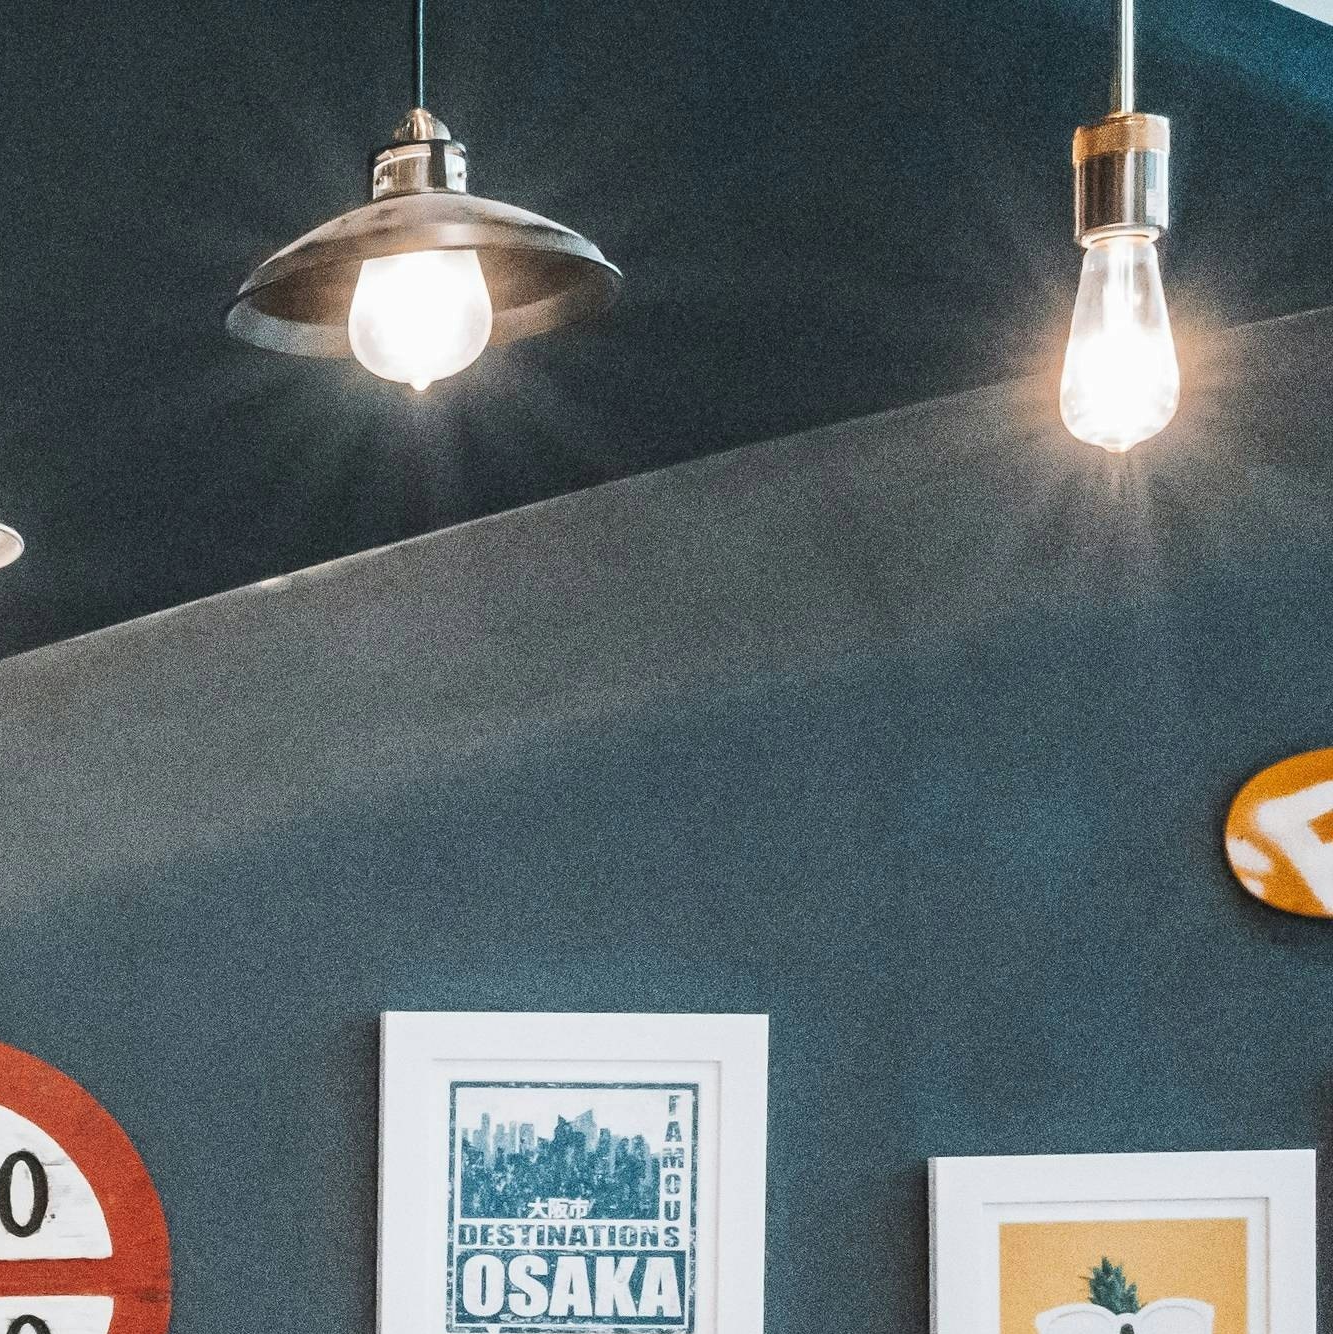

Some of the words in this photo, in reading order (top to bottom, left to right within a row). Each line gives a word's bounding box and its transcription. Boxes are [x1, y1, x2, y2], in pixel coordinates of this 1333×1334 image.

[662, 1094, 684, 1248] FAMOUS
[527, 1198, 591, 1220] 大阪市
[462, 1254, 684, 1318] OSAKA
